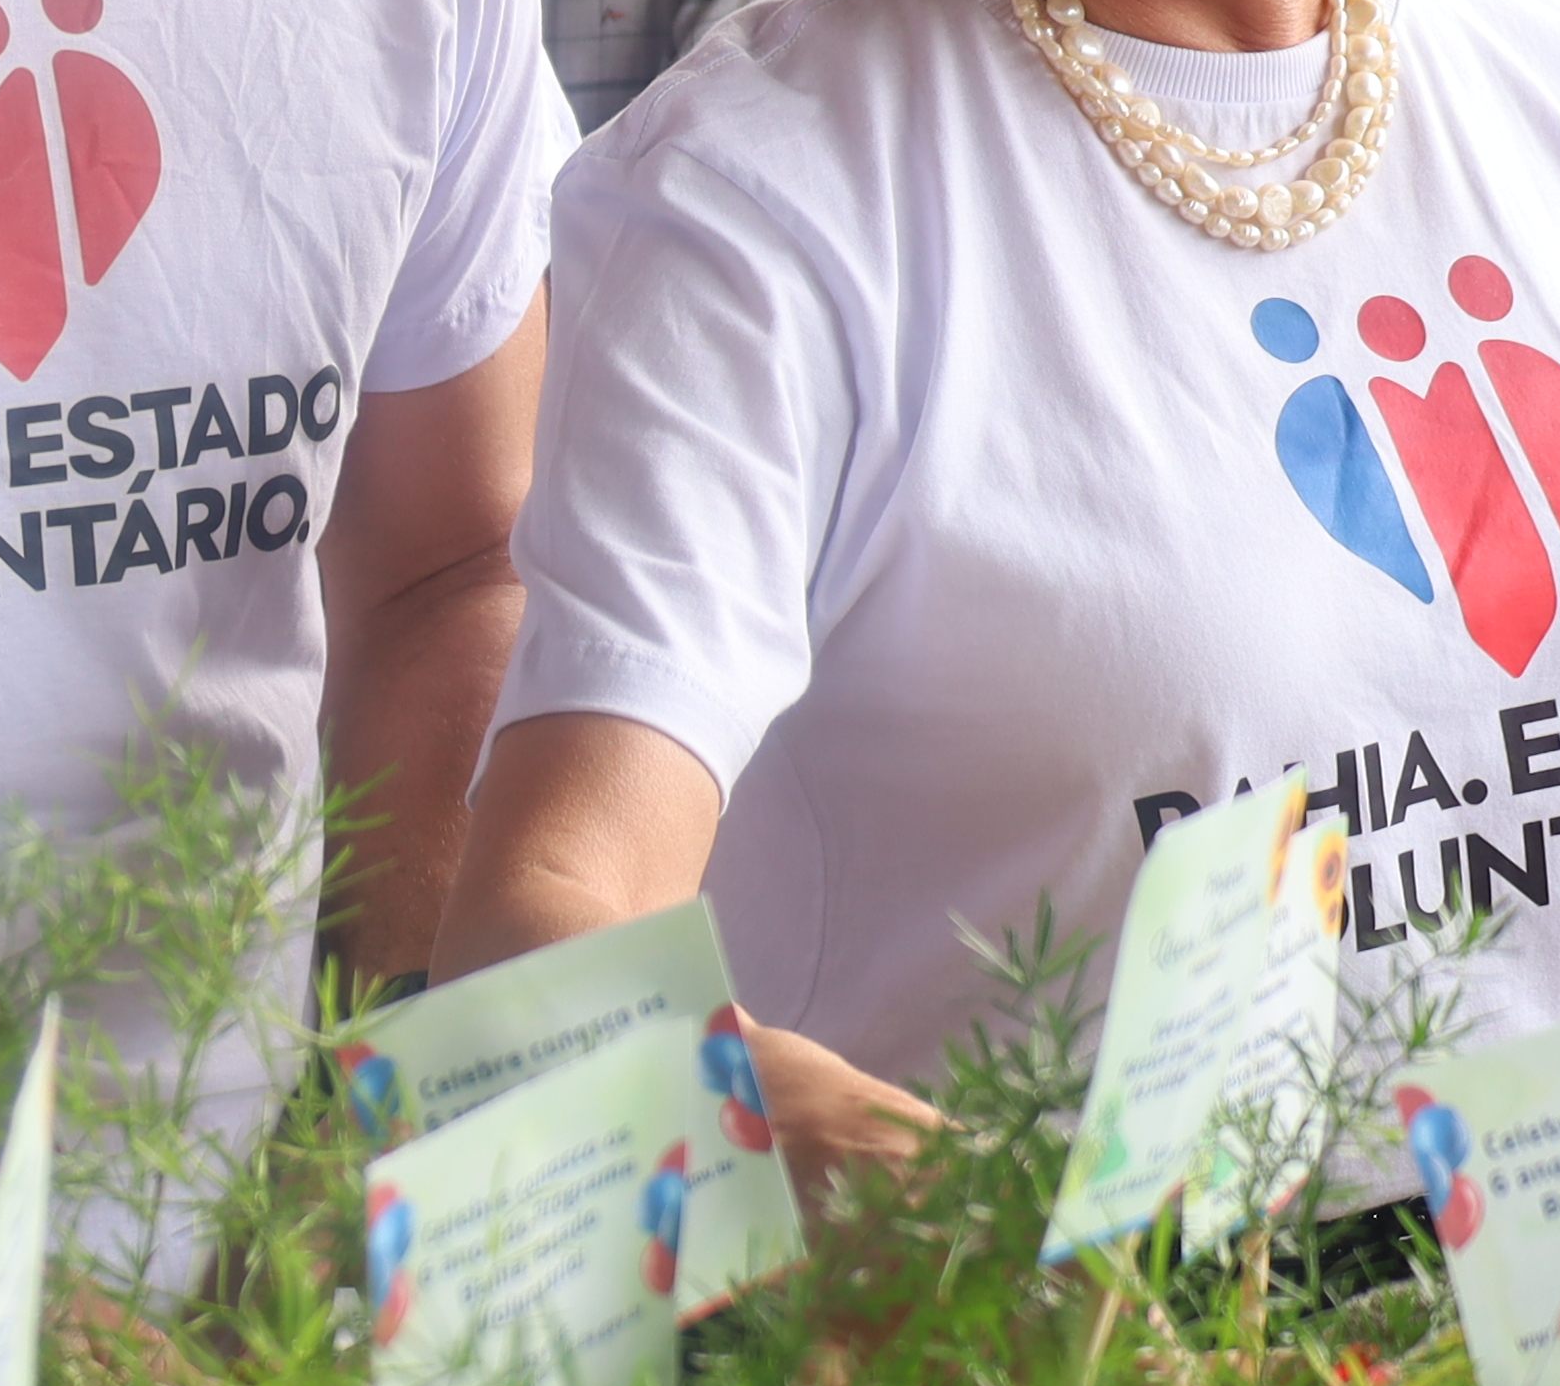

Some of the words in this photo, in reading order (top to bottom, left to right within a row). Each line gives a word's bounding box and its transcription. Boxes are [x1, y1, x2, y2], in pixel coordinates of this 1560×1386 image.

[5, 364, 342, 488] ESTADO
[1132, 729, 1489, 855] HIA.
[418, 1050, 522, 1102] Celebre
